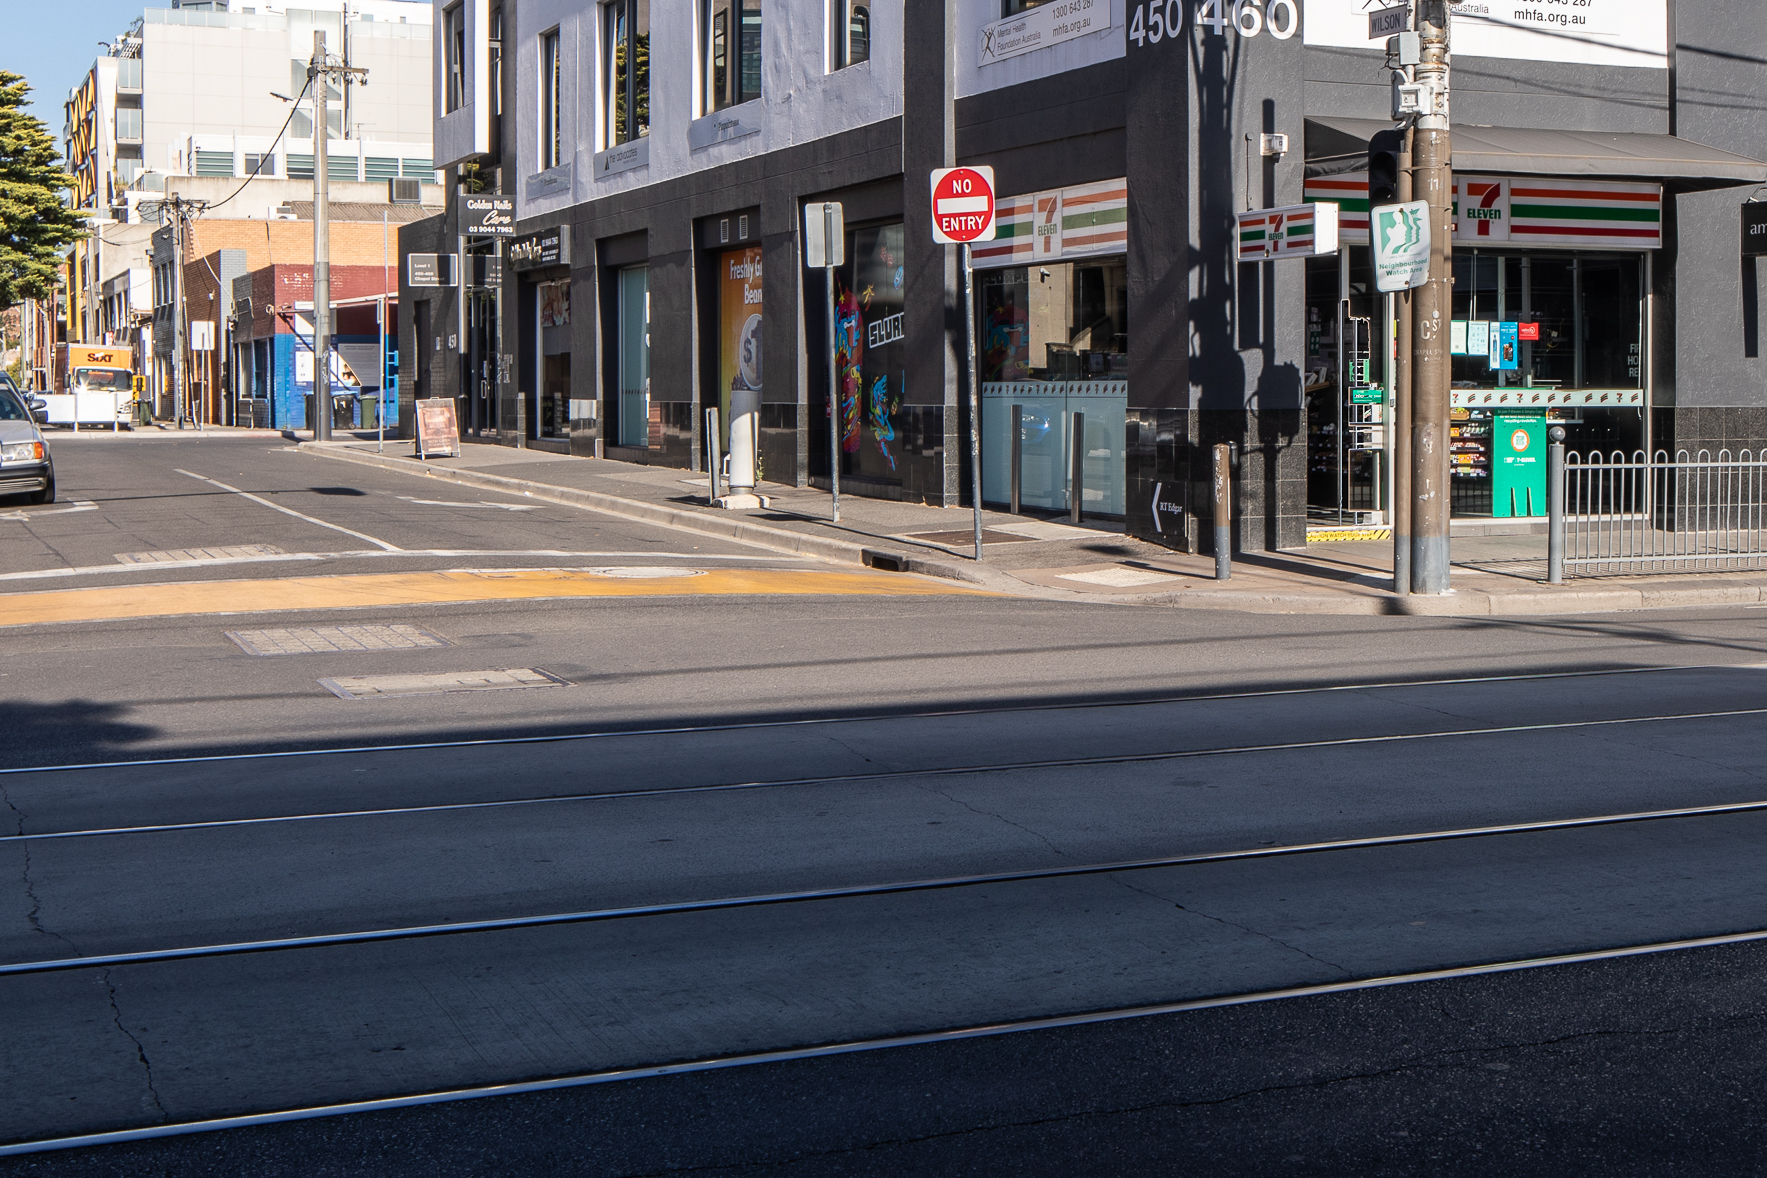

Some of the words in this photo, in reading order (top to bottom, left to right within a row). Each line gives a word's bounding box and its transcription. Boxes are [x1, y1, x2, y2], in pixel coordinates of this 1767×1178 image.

[1052, 4, 1068, 20] 1300
[1069, 0, 1081, 14] 643
[1514, 9, 1586, 26] mhfa.org.au
[997, 26, 1012, 39] Mental
[1012, 21, 1027, 33] Health
[1052, 17, 1091, 37] mhfa.org.au
[1370, 13, 1400, 34] WILSON
[997, 38, 1021, 52] Foundation
[1021, 30, 1042, 44] Australia
[952, 178, 972, 194] NO
[1467, 183, 1501, 236] 7
[942, 215, 985, 232] ENTRY
[1037, 195, 1058, 253] 7
[1268, 213, 1284, 252] 7
[729, 256, 755, 283] Freshly
[1379, 258, 1428, 270] Neighbourhood
[1385, 268, 1408, 277] Watch
[1409, 266, 1423, 274] Area
[744, 283, 763, 305] Bean
[1168, 502, 1183, 514] Edgar
